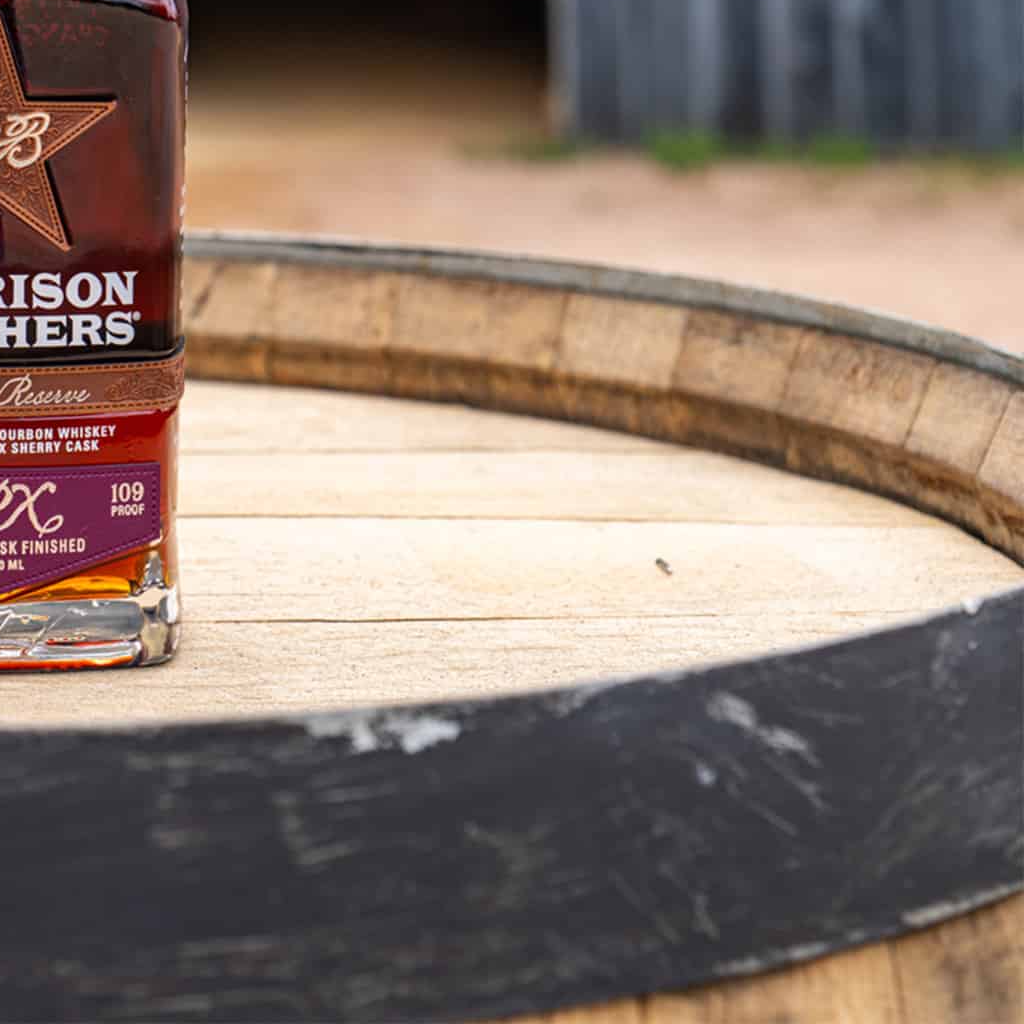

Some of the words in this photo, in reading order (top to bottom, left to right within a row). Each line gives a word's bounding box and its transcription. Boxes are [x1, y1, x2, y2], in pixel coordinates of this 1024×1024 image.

[0, 373, 91, 406] Reserve
[57, 425, 117, 439] WHISKEY
[11, 441, 61, 455] SHERRY
[65, 440, 100, 453] CASK
[111, 481, 145, 503] 109
[111, 503, 145, 517] PROOF
[21, 538, 86, 555] FINISHED
[7, 559, 25, 570] ML
